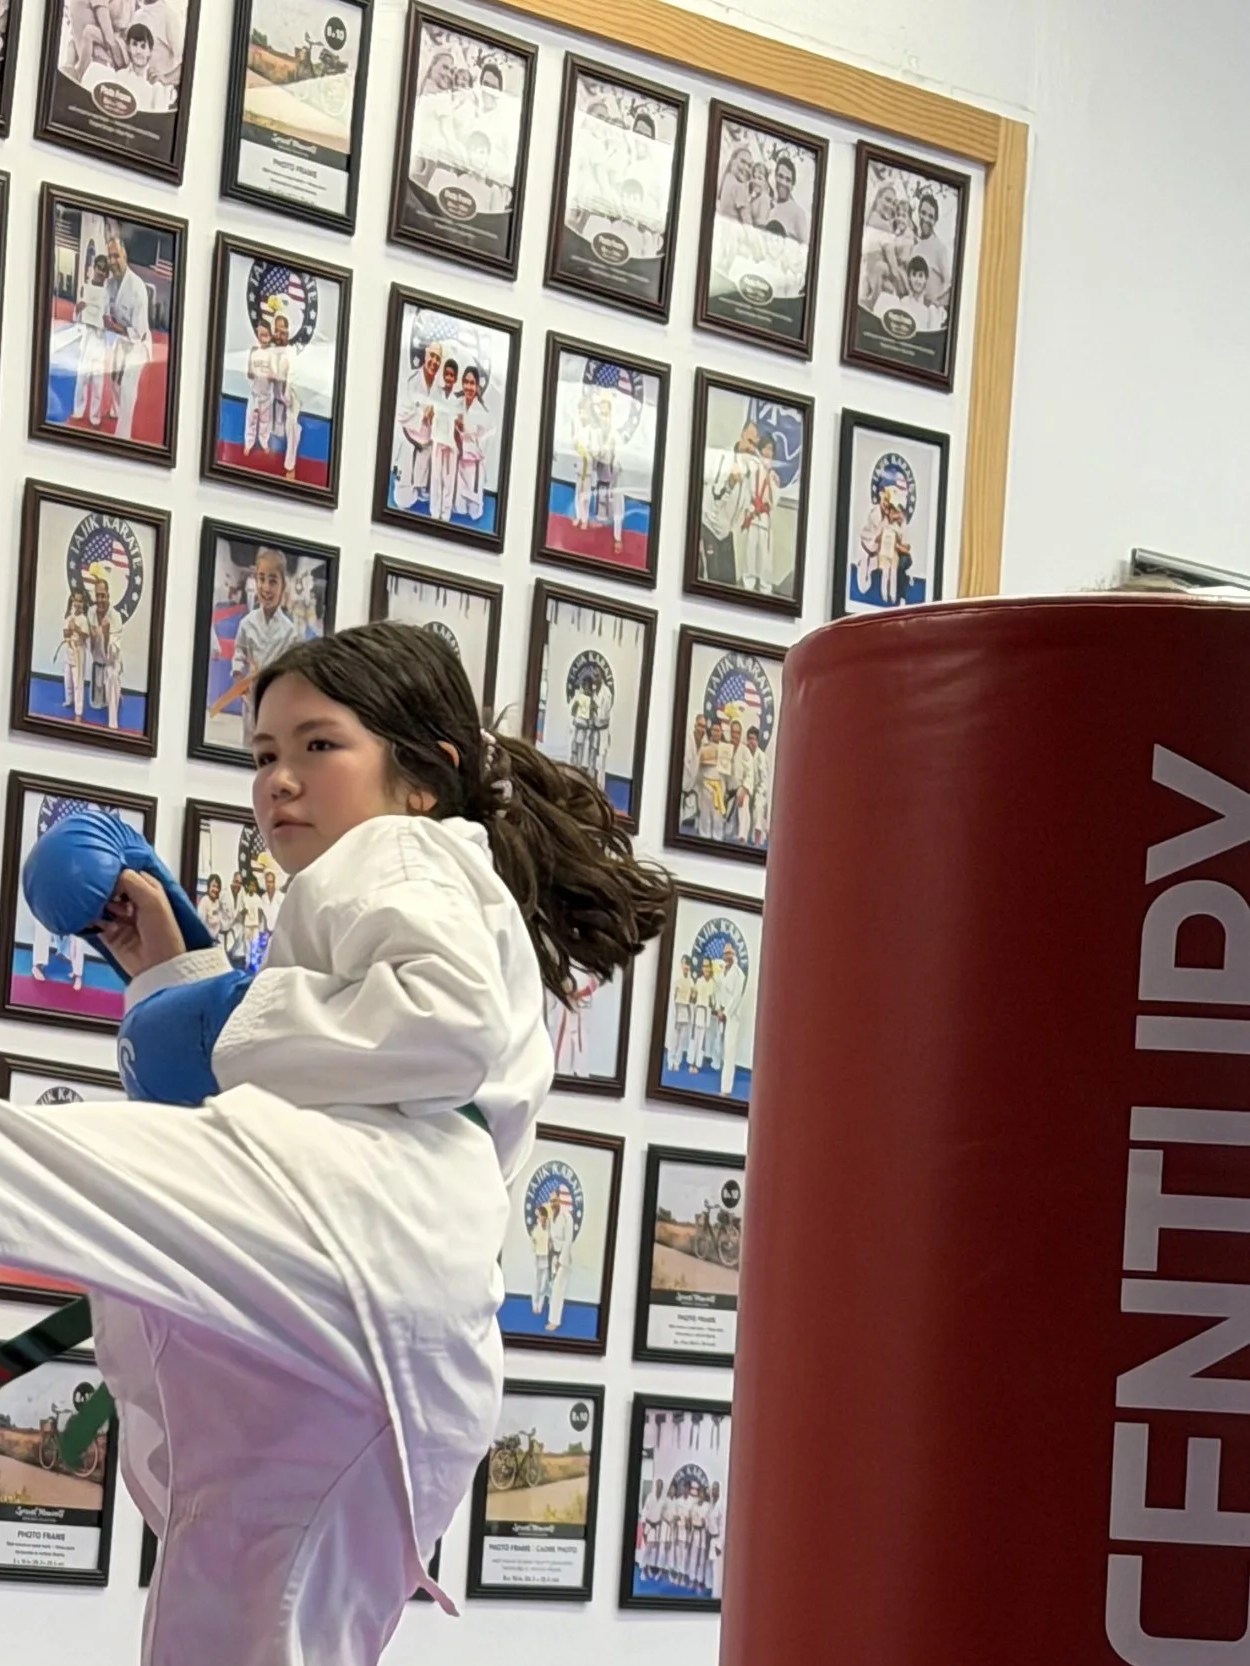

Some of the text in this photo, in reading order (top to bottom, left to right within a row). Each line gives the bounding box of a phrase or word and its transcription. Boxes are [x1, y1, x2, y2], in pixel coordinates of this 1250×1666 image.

[102, 514, 142, 569] KARATE
[17, 1530, 65, 1541] PHOTO FRAME
